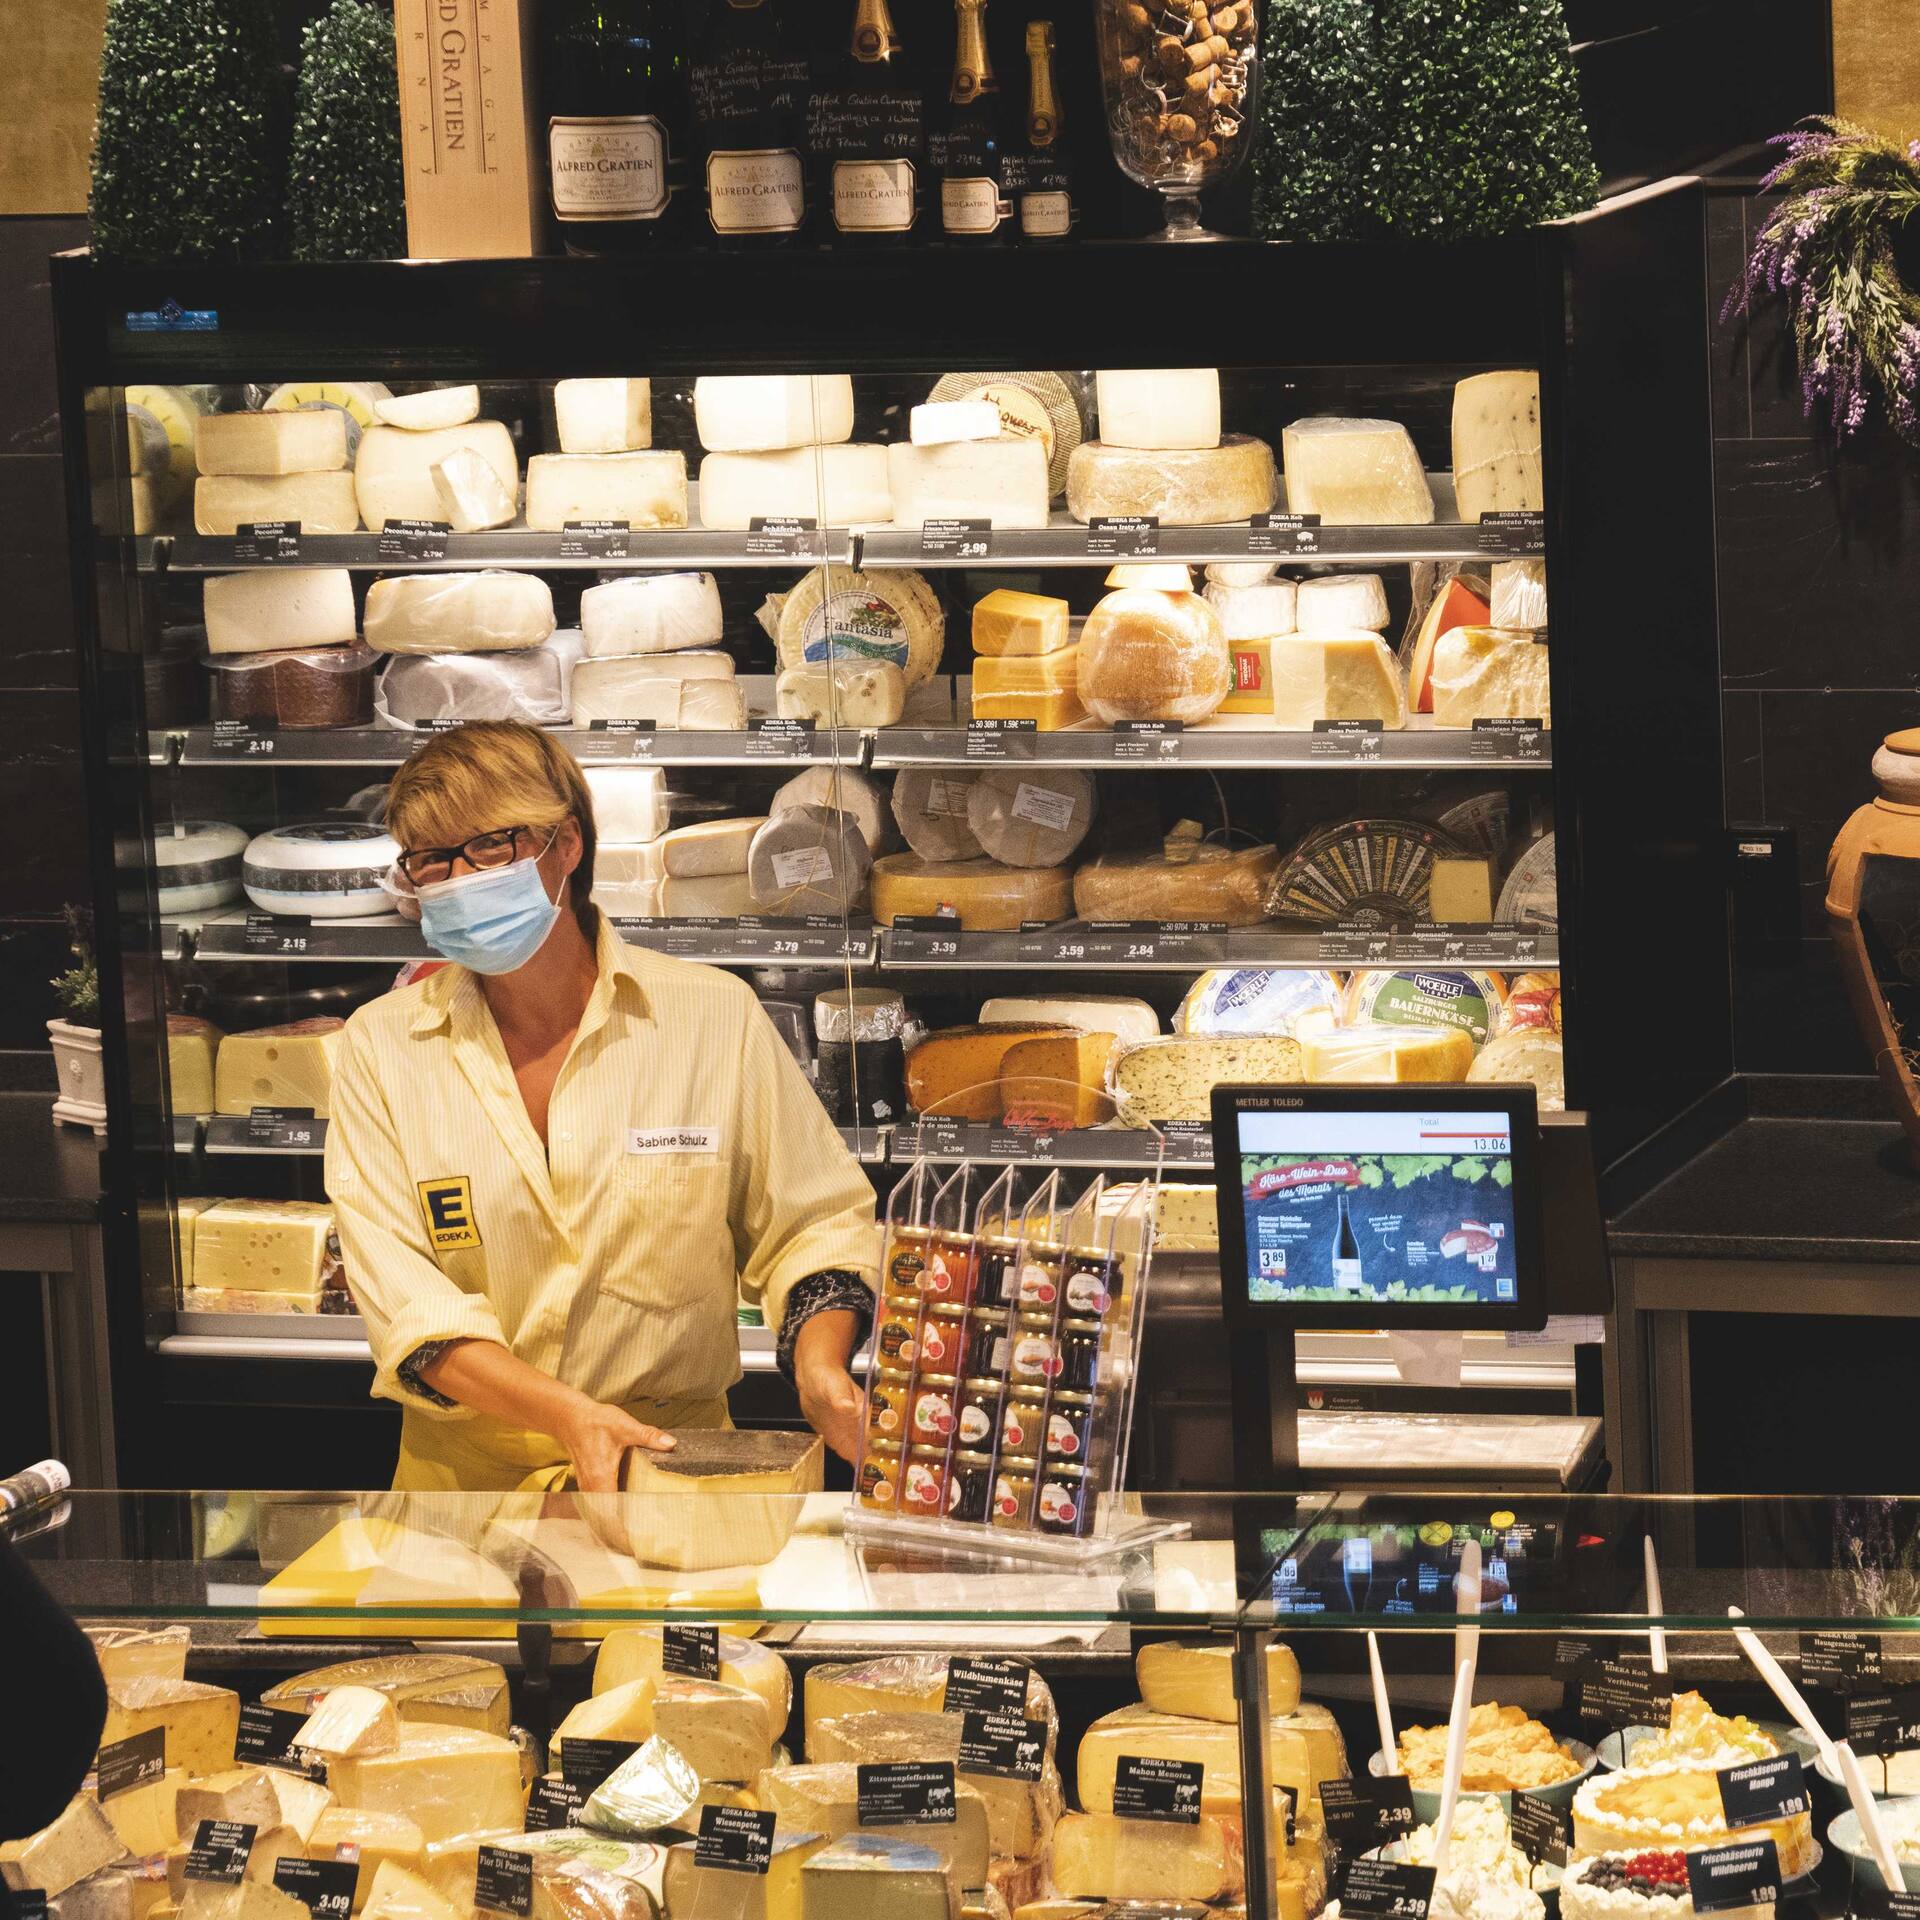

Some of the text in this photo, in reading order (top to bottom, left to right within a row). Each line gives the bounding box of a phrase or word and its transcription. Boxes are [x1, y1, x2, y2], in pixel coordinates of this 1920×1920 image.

[441, 30, 467, 150] GRATIEN
[556, 158, 653, 173] ALFRED GRATIEN
[714, 182, 800, 198] ALFRED GRATIEN
[869, 189, 910, 200] GRATIEN
[1268, 520, 1303, 528] Sovrano
[961, 542, 988, 554] 2.99
[1133, 546, 1157, 555] 3,49€
[1295, 544, 1319, 552] 3,49€
[823, 614, 895, 640] Fantasia
[984, 720, 998, 729] 3091
[1003, 720, 1019, 729] 1.59€
[249, 740, 275, 752] 2.19
[1354, 753, 1381, 761] 2,19€
[1518, 749, 1541, 757] 2,99€
[1193, 923, 1209, 932] 2.79€
[282, 938, 306, 948] 2.15
[774, 941, 799, 952] 3.79
[932, 942, 957, 953] 3.39
[1059, 945, 1084, 956] 3.59
[1129, 945, 1154, 956] 2.84
[1230, 974, 1268, 1006] WOERLE
[1418, 977, 1459, 995] WOERLE
[1412, 995, 1458, 1009] SALZBURGER
[1389, 997, 1476, 1027] BAUERNKÄSE
[1236, 1098, 1304, 1107] METTLER TOLEDO
[1419, 1118, 1439, 1126] Total
[287, 1131, 311, 1141] 1.95
[637, 1134, 708, 1148] Sabine Schulz
[1474, 1139, 1506, 1150] 13.06
[1278, 1188, 1295, 1199] des
[1294, 1182, 1332, 1197] Monats
[427, 1187, 467, 1230] E
[436, 1231, 473, 1243] EDEKA
[1262, 1252, 1271, 1267] 3
[680, 1627, 699, 1637] Gouda
[970, 1660, 1010, 1673] EDEKA Kolb
[1604, 1664, 1649, 1677] EDEKA Kolb
[1856, 1664, 1881, 1674] 1,49€
[953, 1669, 1024, 1687] Wildblumenkäse
[986, 1716, 1027, 1728] EDEKA Kolb
[983, 1724, 1028, 1737] Gewürzhexe
[138, 1758, 163, 1778] 2.39
[1015, 1761, 1042, 1772] 2,79€
[1140, 1758, 1182, 1769] EDEKA Kolb
[1128, 1767, 1192, 1780] Mahon Menorca
[1730, 1760, 1790, 1783] Frischkäsetorte
[547, 1780, 577, 1793] EDEKA Kolb
[1749, 1776, 1776, 1792] Mango
[538, 1787, 582, 1804] Pestokäse grün
[721, 1807, 758, 1819] EDEKA Kolb
[920, 1807, 955, 1819] 2,89€
[1172, 1803, 1200, 1814] 2,89€
[1378, 1807, 1412, 1822] 2.39
[715, 1816, 761, 1831] Wiesenpeter
[745, 1852, 770, 1865] 2,39€
[1700, 1846, 1764, 1866] Frischkäsetorte
[504, 1860, 531, 1874] Pascolo
[1711, 1860, 1759, 1878] Wildbeeren
[319, 1894, 351, 1910] 3.09
[1393, 1896, 1427, 1914] 2.39
